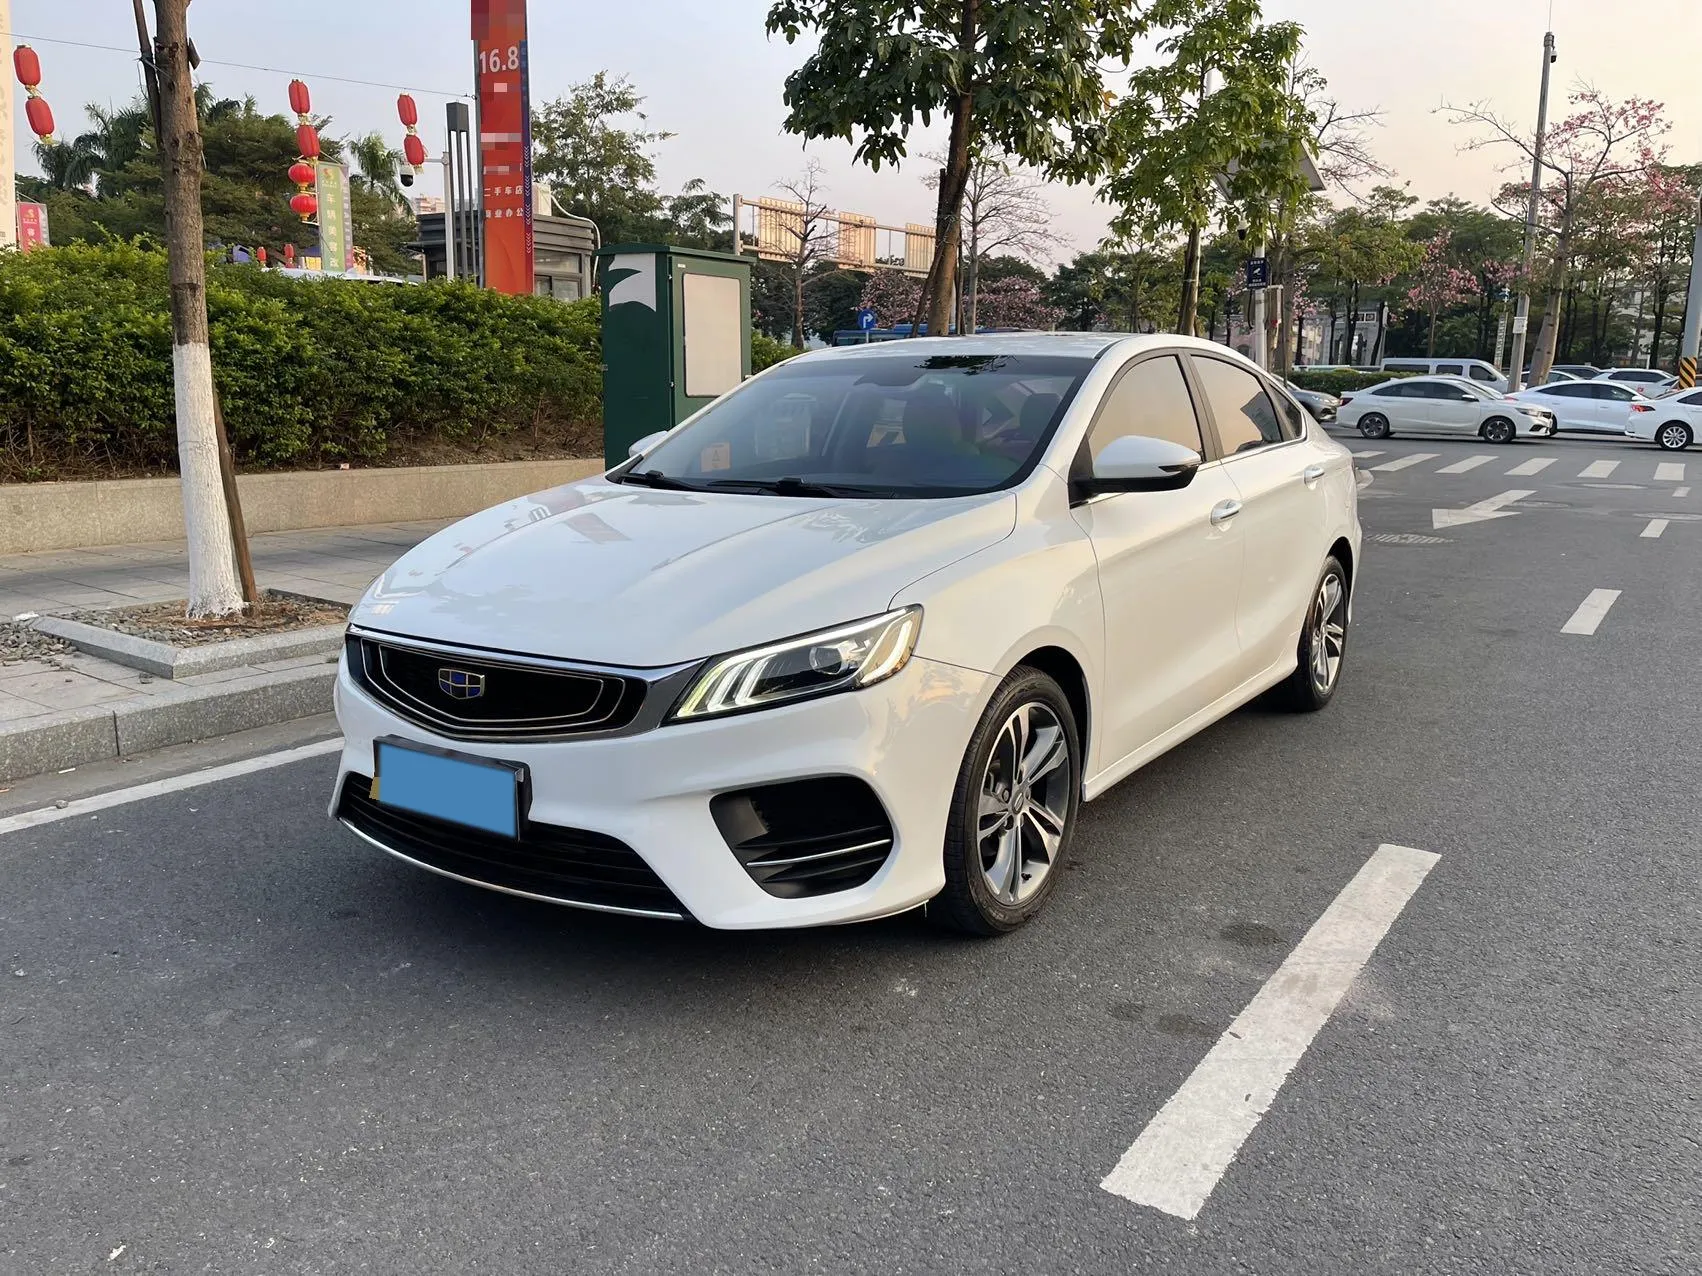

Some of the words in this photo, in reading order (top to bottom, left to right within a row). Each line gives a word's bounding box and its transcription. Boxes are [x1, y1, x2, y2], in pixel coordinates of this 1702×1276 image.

[479, 46, 519, 74] 16.8
[484, 185, 523, 197] 二手车店
[485, 207, 523, 218] 商业办公
